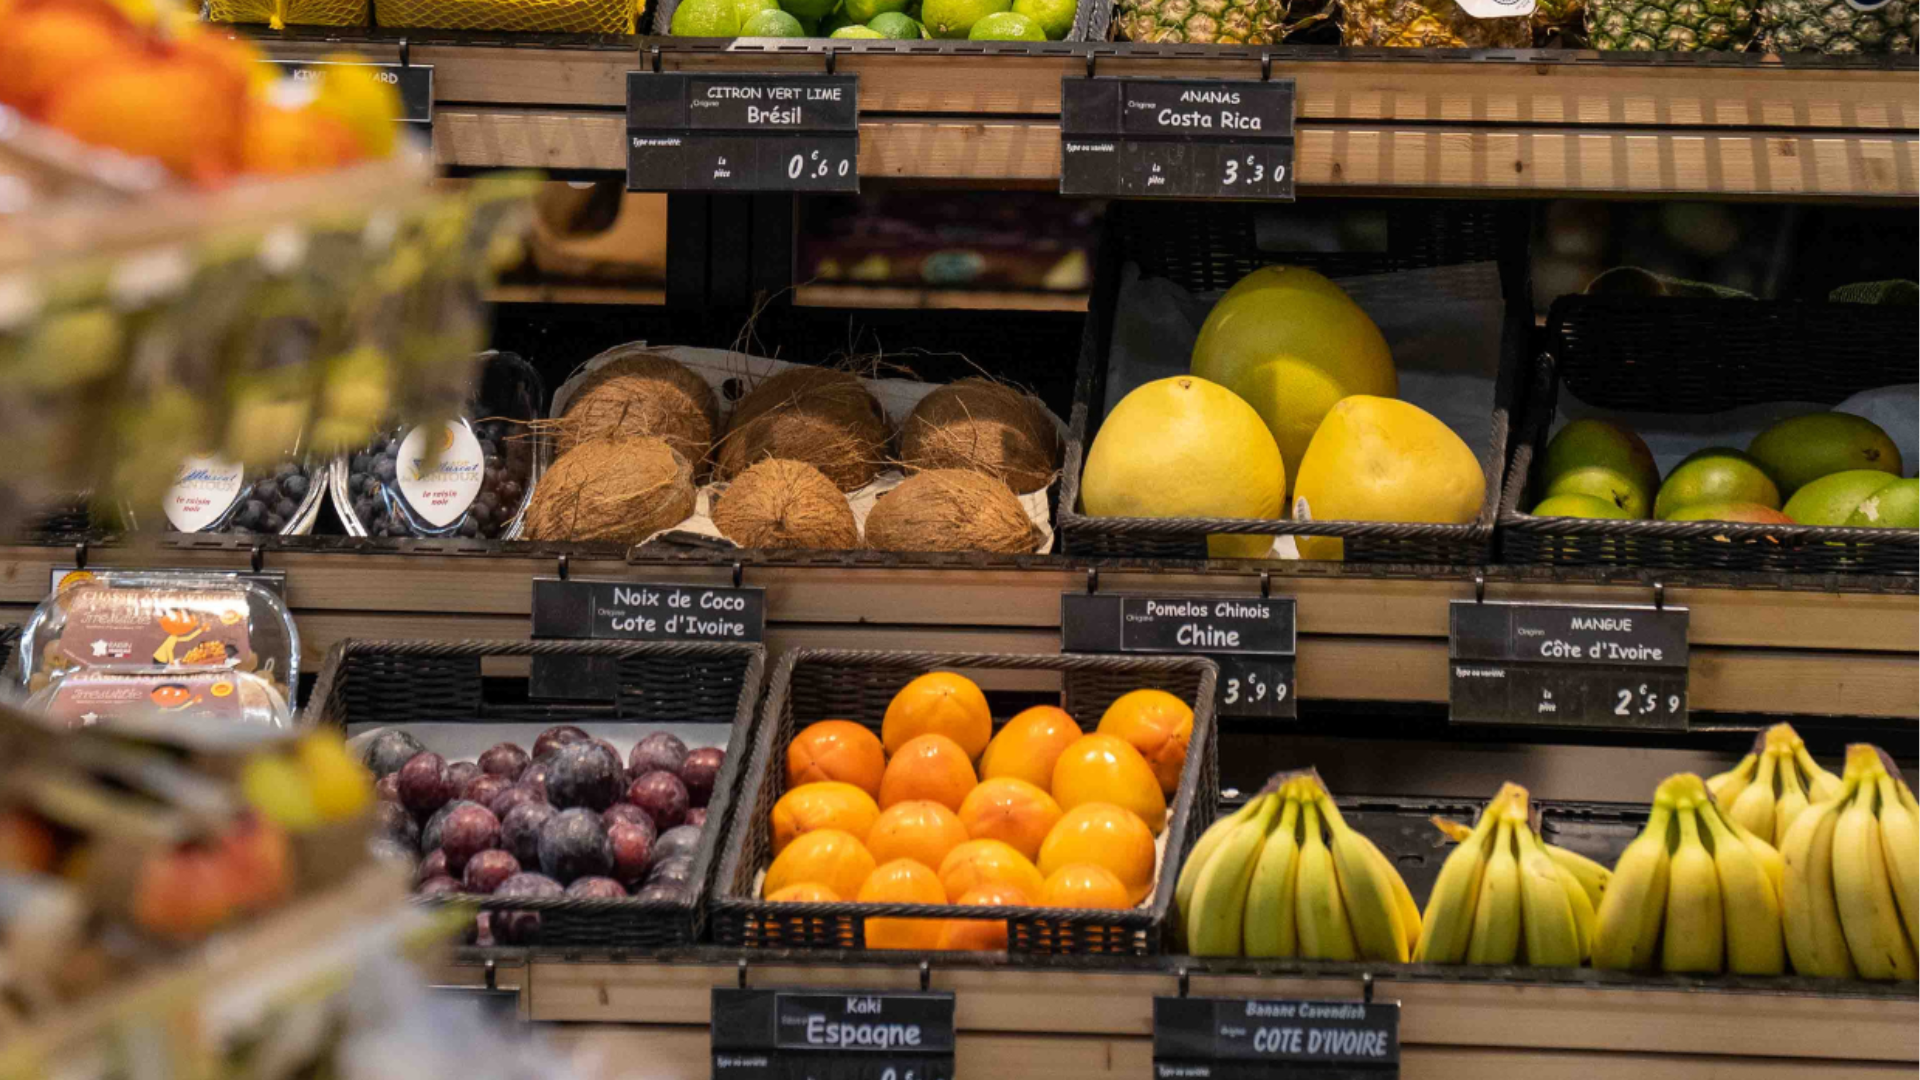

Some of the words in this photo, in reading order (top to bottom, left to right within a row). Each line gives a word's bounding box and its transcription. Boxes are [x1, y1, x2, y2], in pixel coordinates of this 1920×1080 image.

[707, 86, 762, 99] CITRON
[767, 87, 802, 100] VERT
[807, 88, 842, 101] LIME
[1180, 90, 1241, 105] ANANAS
[747, 106, 802, 124] Brésil
[1158, 108, 1213, 128] Costa
[1220, 110, 1261, 130] Rica
[613, 587, 660, 607] Noix
[667, 589, 692, 608] de
[700, 591, 745, 611] Coco
[1147, 601, 1208, 617] Pomelos
[1215, 602, 1270, 619] Chinois
[665, 615, 745, 636] d'Ivoire
[1570, 617, 1632, 632] MANGUE
[1176, 623, 1240, 647] Chine
[1540, 639, 1582, 658] Côte
[1589, 642, 1663, 661] d'Ivoire
[847, 998, 882, 1014] Kaki
[1246, 1002, 1296, 1018] Banane
[1300, 1003, 1366, 1020] Cavendish
[807, 1014, 921, 1048] Espagne
[1253, 1026, 1303, 1053] COTE
[1307, 1027, 1388, 1056] D'IVOIRE
